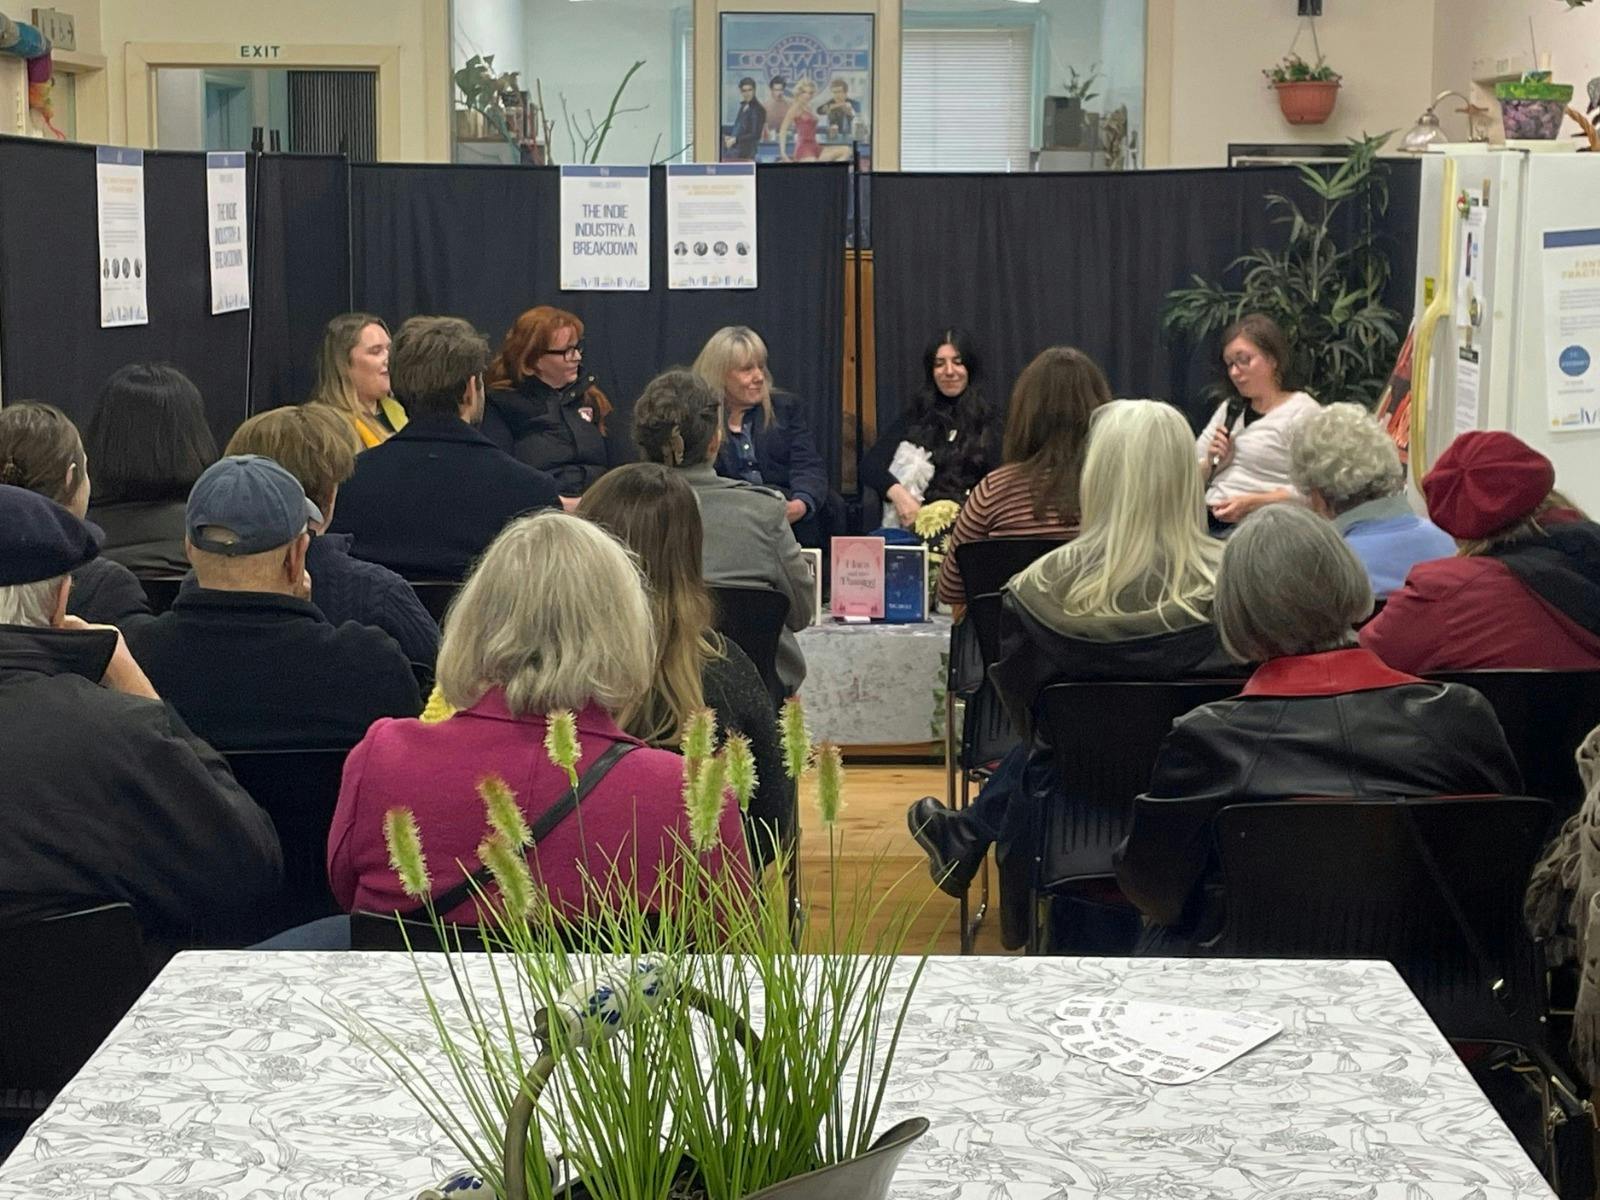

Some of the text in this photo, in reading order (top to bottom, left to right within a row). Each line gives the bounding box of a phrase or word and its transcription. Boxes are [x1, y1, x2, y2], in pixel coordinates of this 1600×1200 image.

[240, 45, 281, 58] EXIT
[582, 203, 629, 219] THE INDIE
[628, 223, 636, 237] A
[573, 240, 638, 256] BREAKDOWN
